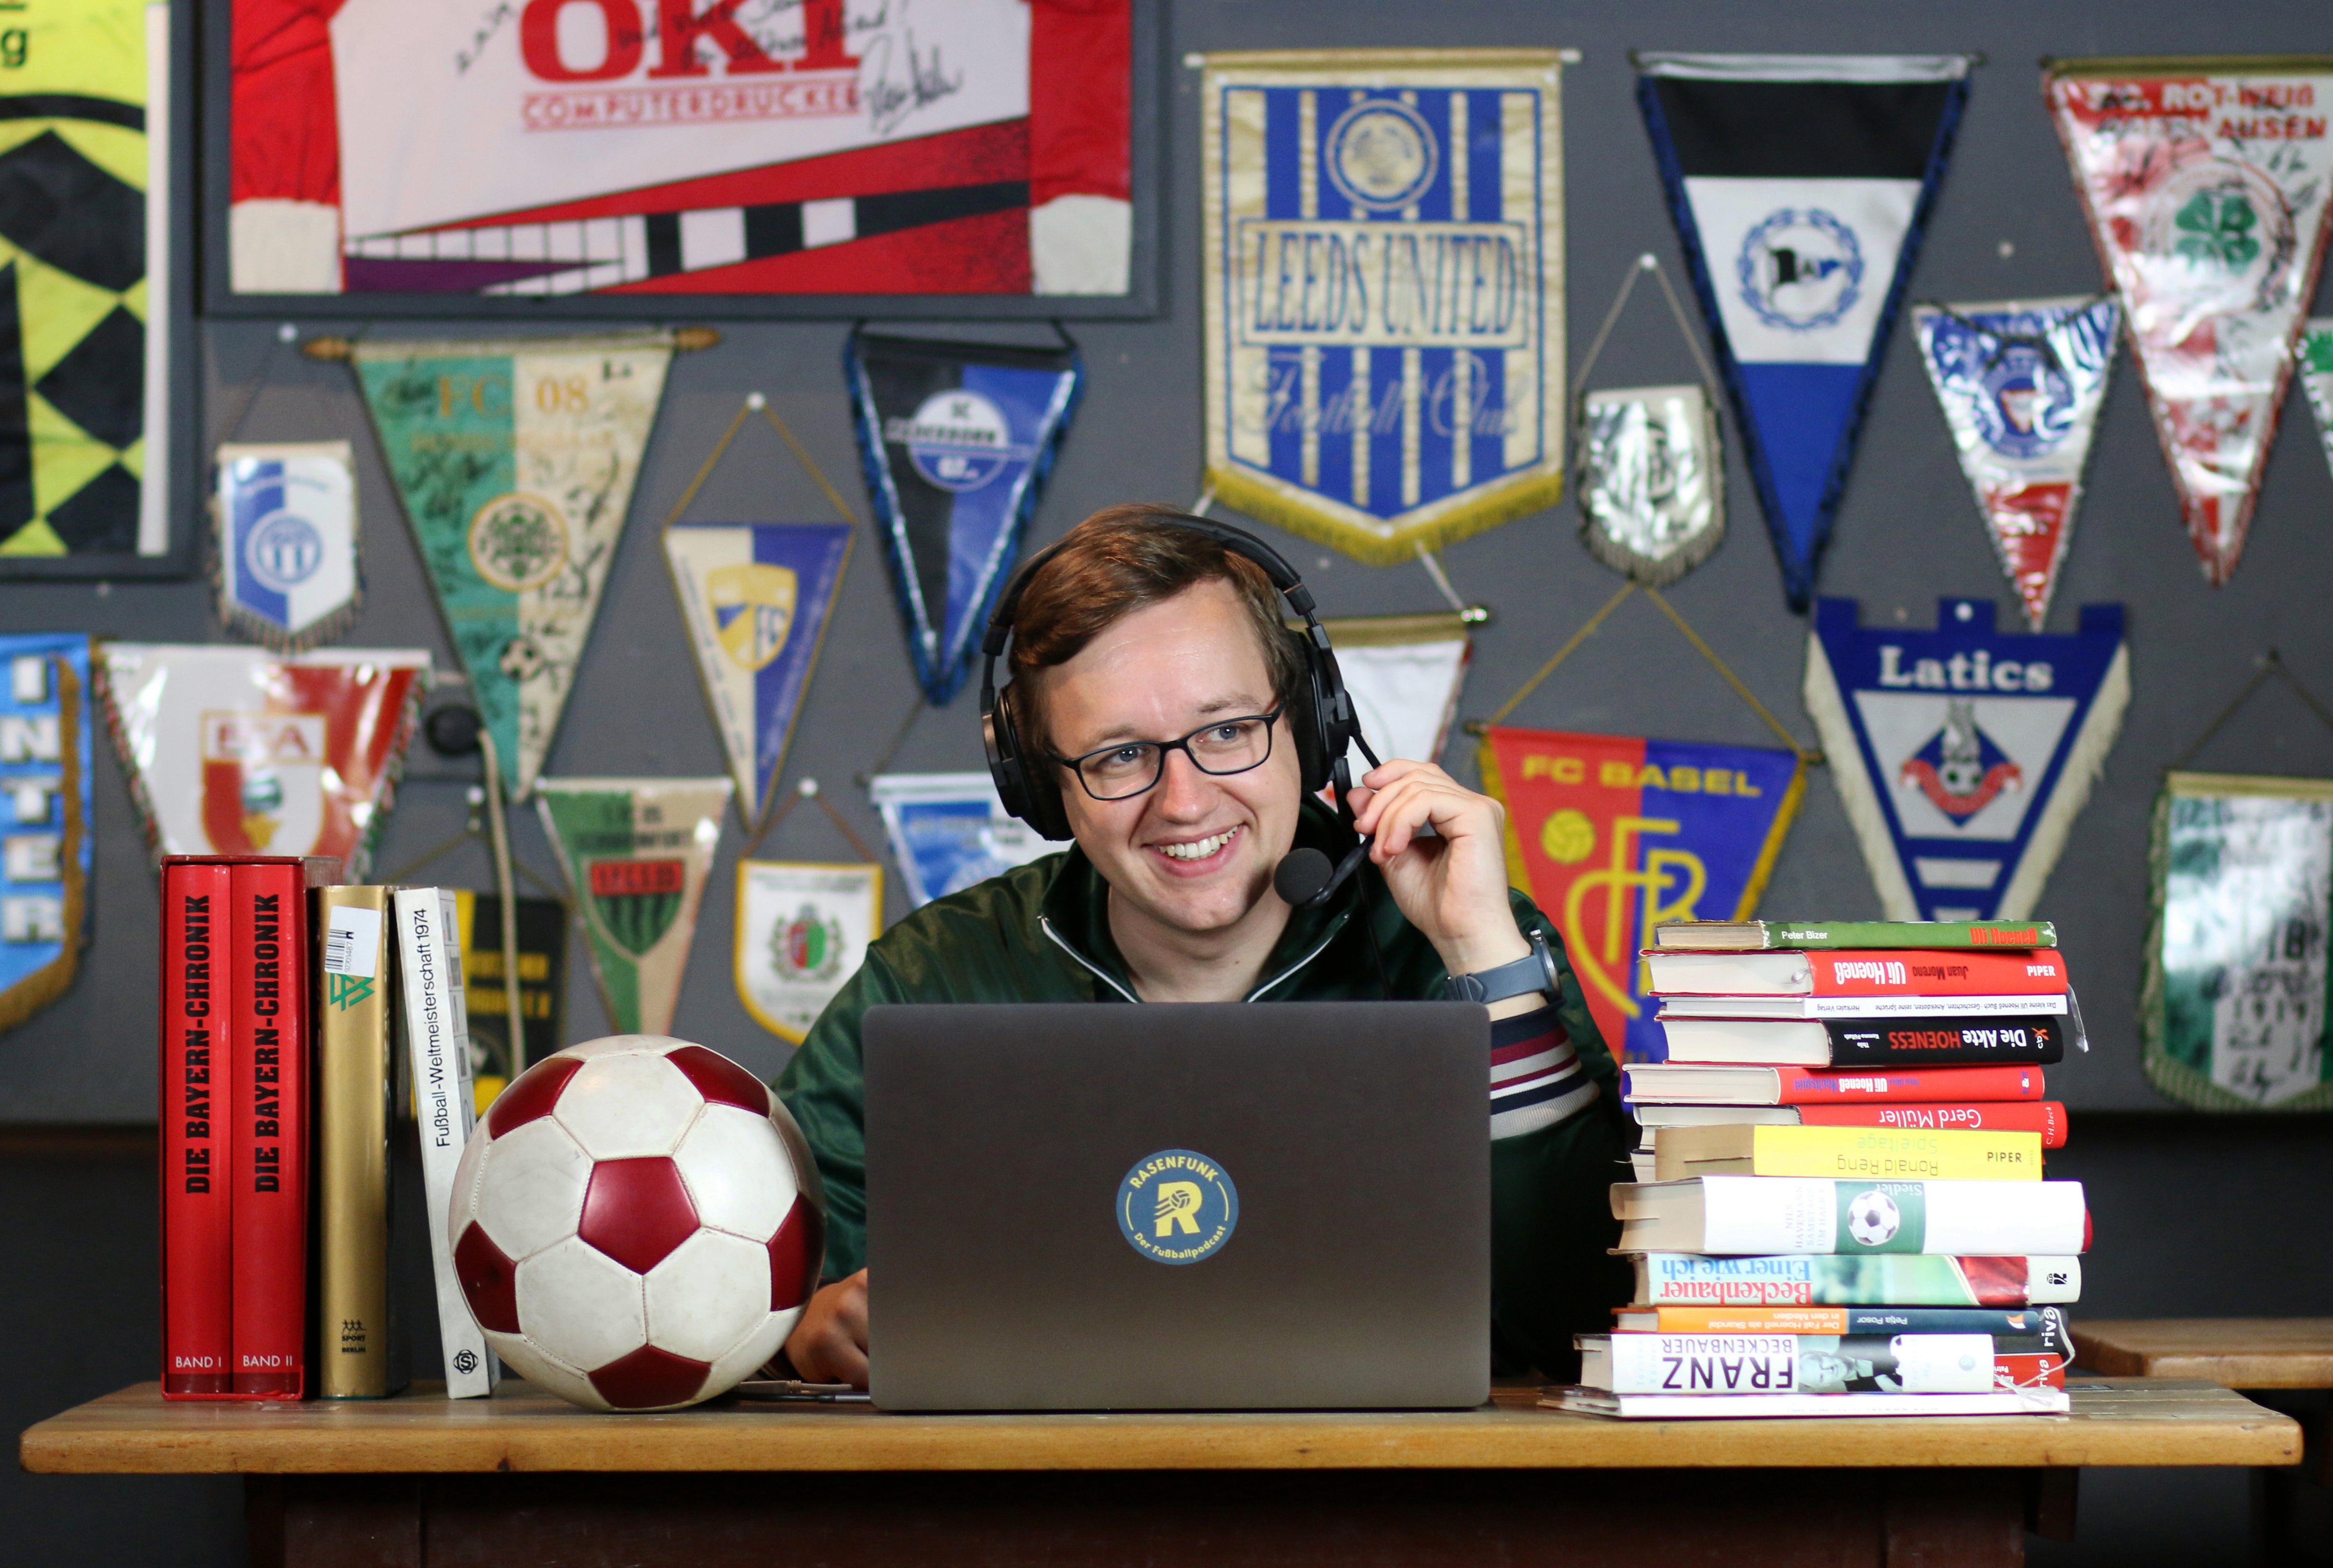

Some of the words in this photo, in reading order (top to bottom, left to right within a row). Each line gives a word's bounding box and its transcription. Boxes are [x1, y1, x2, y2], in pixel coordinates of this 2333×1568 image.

[520, 0, 860, 83] OKI
[1254, 231, 1371, 335] LEEDS
[1383, 233, 1517, 338] UNITED
[437, 373, 512, 419] FC
[535, 376, 590, 416] 08
[1878, 645, 2054, 692] Latics
[1522, 755, 1585, 784] FC
[1599, 762, 1762, 797] BASEL
[413, 908, 430, 940] 1974
[1782, 930, 1804, 940] Peter
[1806, 930, 1828, 940] Bizer
[1834, 962, 1886, 985] Hoeneß
[1886, 962, 1907, 985] Uli
[1913, 966, 1946, 980] Moreno
[1947, 966, 1969, 979] Juan
[2026, 965, 2056, 977] PIPER
[185, 895, 210, 1138] BAYERN-CHRONIK
[255, 894, 279, 1137] BAYERN-CHRONIK
[417, 943, 451, 1148] Fußball-Weltmeisterschaft
[1888, 1030, 1961, 1050] HOENESS
[1962, 1029, 1998, 1048] Akte
[2000, 1029, 2027, 1048] Die
[1839, 1077, 1874, 1093] Hoeneß
[1875, 1077, 1888, 1093] Uli
[1879, 1109, 1933, 1128] Müller
[1938, 1109, 1982, 1129] Gerd
[2045, 1105, 2054, 1146] C.H.Beck
[1857, 1134, 1938, 1154] Spieltage
[1837, 1154, 1879, 1174] Reng
[1885, 1158, 1938, 1176] Ronald
[1987, 1151, 2022, 1163] PIPER
[185, 1148, 210, 1194] DIE
[255, 1147, 279, 1193] DIE
[1129, 1156, 1219, 1189] RASENFUNK
[1875, 1183, 1923, 1196] Siedler
[1153, 1181, 1203, 1237] R
[1134, 1232, 1151, 1249] Der
[1152, 1225, 1226, 1259] Fußballpodcast
[1662, 1259, 1695, 1280] ich
[1702, 1259, 1741, 1281] wie
[1749, 1260, 1813, 1281] Einer
[1659, 1281, 1813, 1305] Beckenbauer
[1708, 1321, 1746, 1330] Skandal
[1749, 1321, 1762, 1329] als
[1764, 1321, 1802, 1330] Hoeneß
[1804, 1321, 1820, 1329] Fall
[1822, 1321, 1840, 1329] Der
[1857, 1315, 1883, 1325] Posor
[2041, 1308, 2057, 1347] riva
[1661, 1338, 1792, 1353] BECKENBAUER
[175, 1356, 214, 1368] BAND
[218, 1356, 221, 1367] I
[243, 1355, 281, 1367] BAND
[286, 1354, 293, 1367] II
[1662, 1357, 1793, 1389] FRANZ
